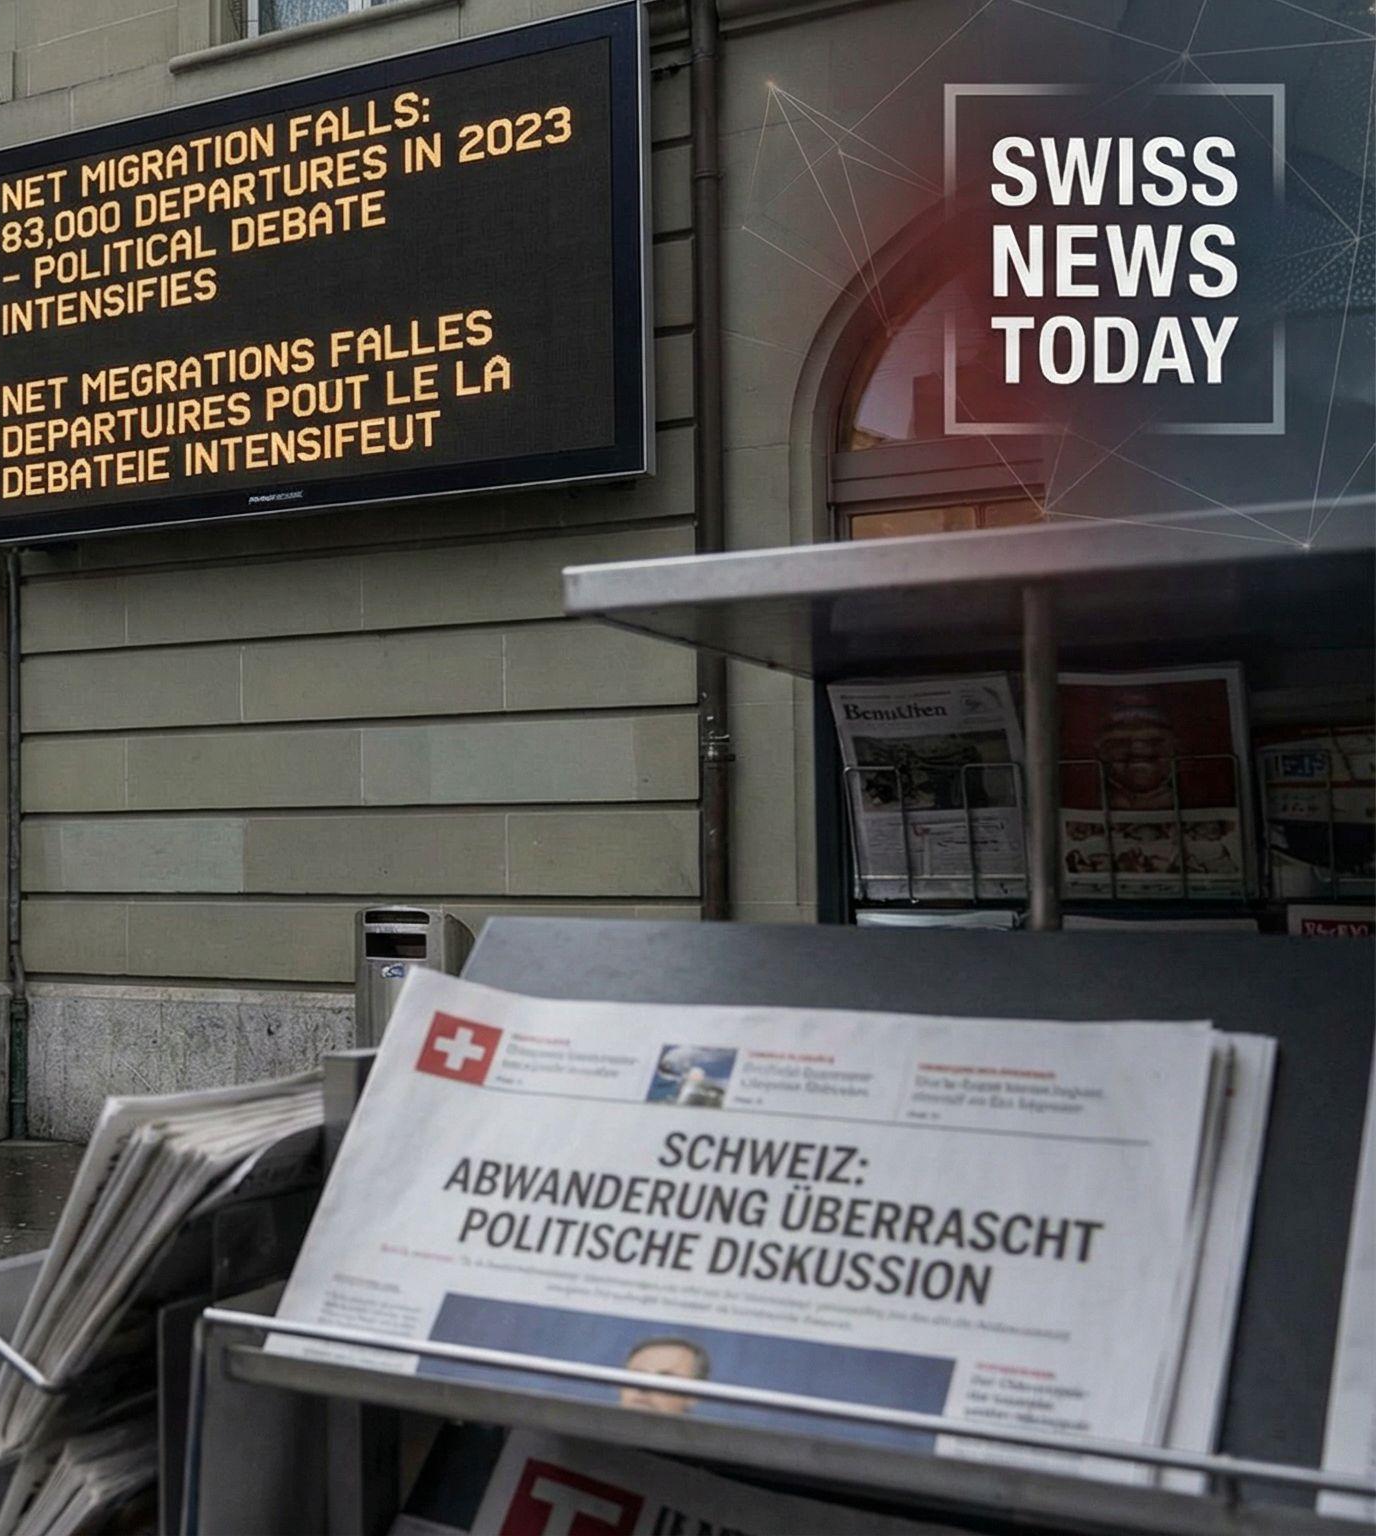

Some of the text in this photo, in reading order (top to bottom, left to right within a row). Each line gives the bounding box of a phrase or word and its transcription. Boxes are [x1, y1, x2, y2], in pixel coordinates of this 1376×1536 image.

[1, 105, 572, 252] 83,000 DEPARTURES IN 2023
[2, 91, 430, 213] NET MIGRATION FALLS:
[34, 225, 217, 289] POLITICAL
[231, 190, 386, 251] DEBATE
[2, 268, 217, 335] INTENSIFIES
[2, 310, 493, 417] NET MEGRATIONS FALLES
[2, 354, 511, 458] DEPARTUIRES POUT LE LA
[2, 411, 441, 499] DEBATEIE INTENSIFEUT
[657, 1131, 869, 1186] SCHWEIZ:
[443, 1157, 1106, 1264] ABWANDERUNG ÜBERRASCHT
[458, 1207, 701, 1272] POLITISCHE
[708, 1236, 994, 1307] DISKUSSION
